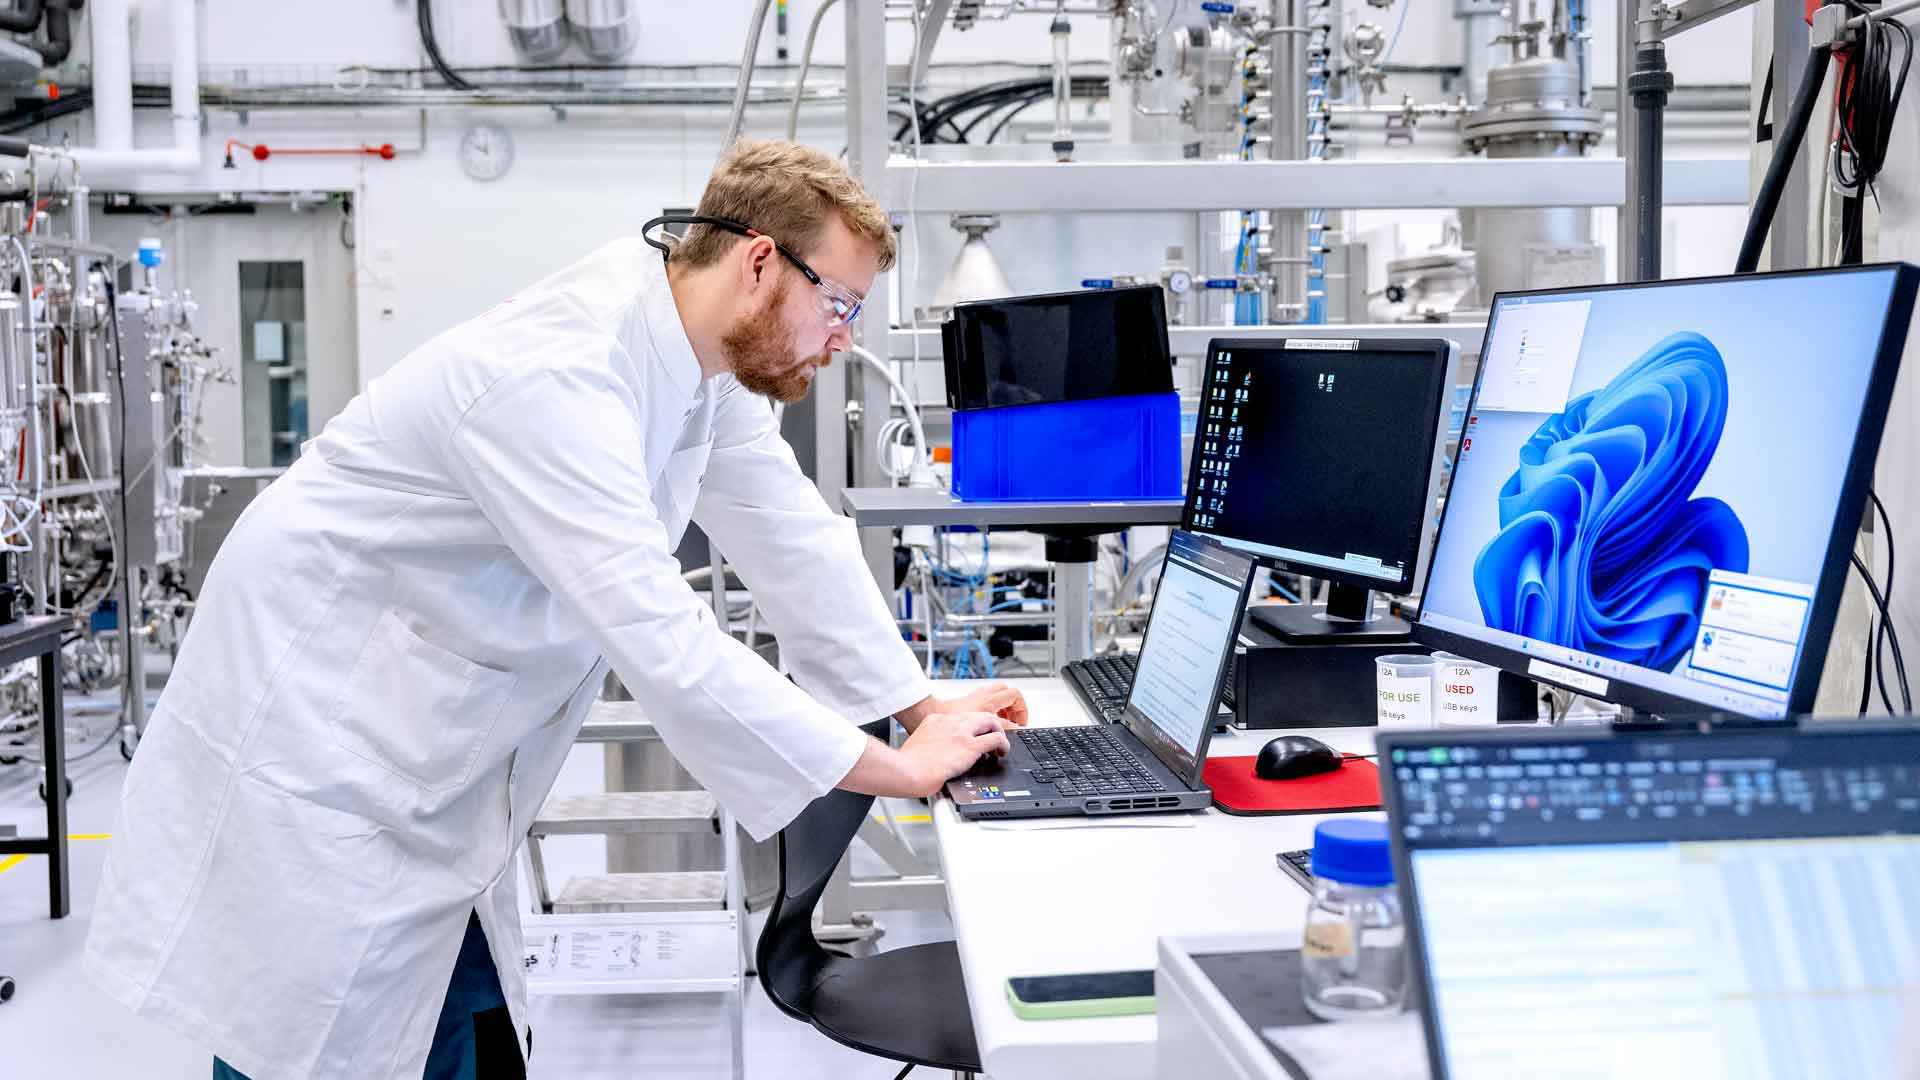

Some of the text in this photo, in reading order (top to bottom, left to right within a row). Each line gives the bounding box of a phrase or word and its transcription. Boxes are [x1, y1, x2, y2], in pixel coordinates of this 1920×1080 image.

[1455, 668, 1470, 676] 12A
[1445, 682, 1474, 695] USED
[1398, 692, 1422, 703] USE
[1459, 704, 1478, 713] keys
[1388, 711, 1406, 720] keys
